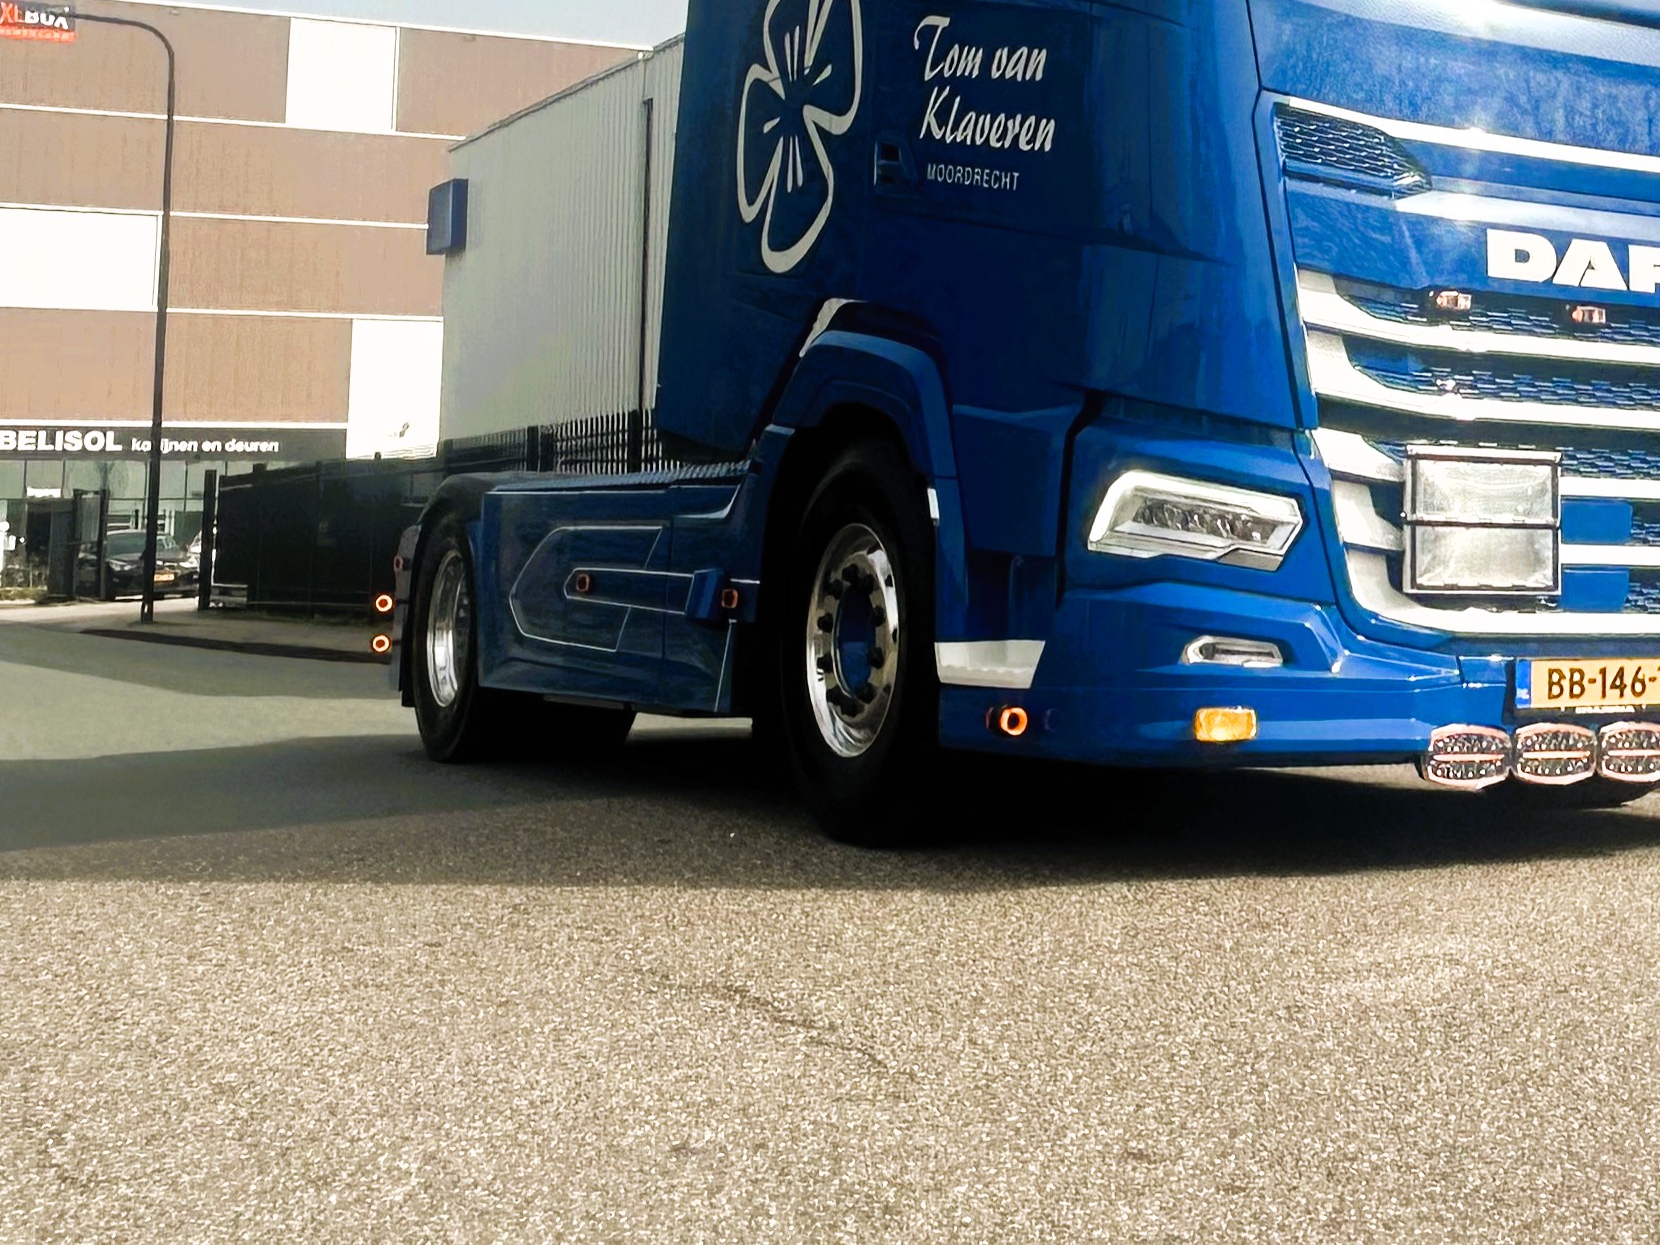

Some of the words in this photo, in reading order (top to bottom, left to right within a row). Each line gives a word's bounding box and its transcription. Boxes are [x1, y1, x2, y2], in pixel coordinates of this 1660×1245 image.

[913, 15, 984, 82] Tom
[990, 45, 1047, 82] van
[919, 85, 1056, 153] Klaveren
[926, 163, 1020, 192] MOORDRECHT
[0, 429, 123, 452] BELISOL
[131, 437, 198, 454] koijnen
[201, 439, 222, 453] en
[224, 438, 279, 453] deuren
